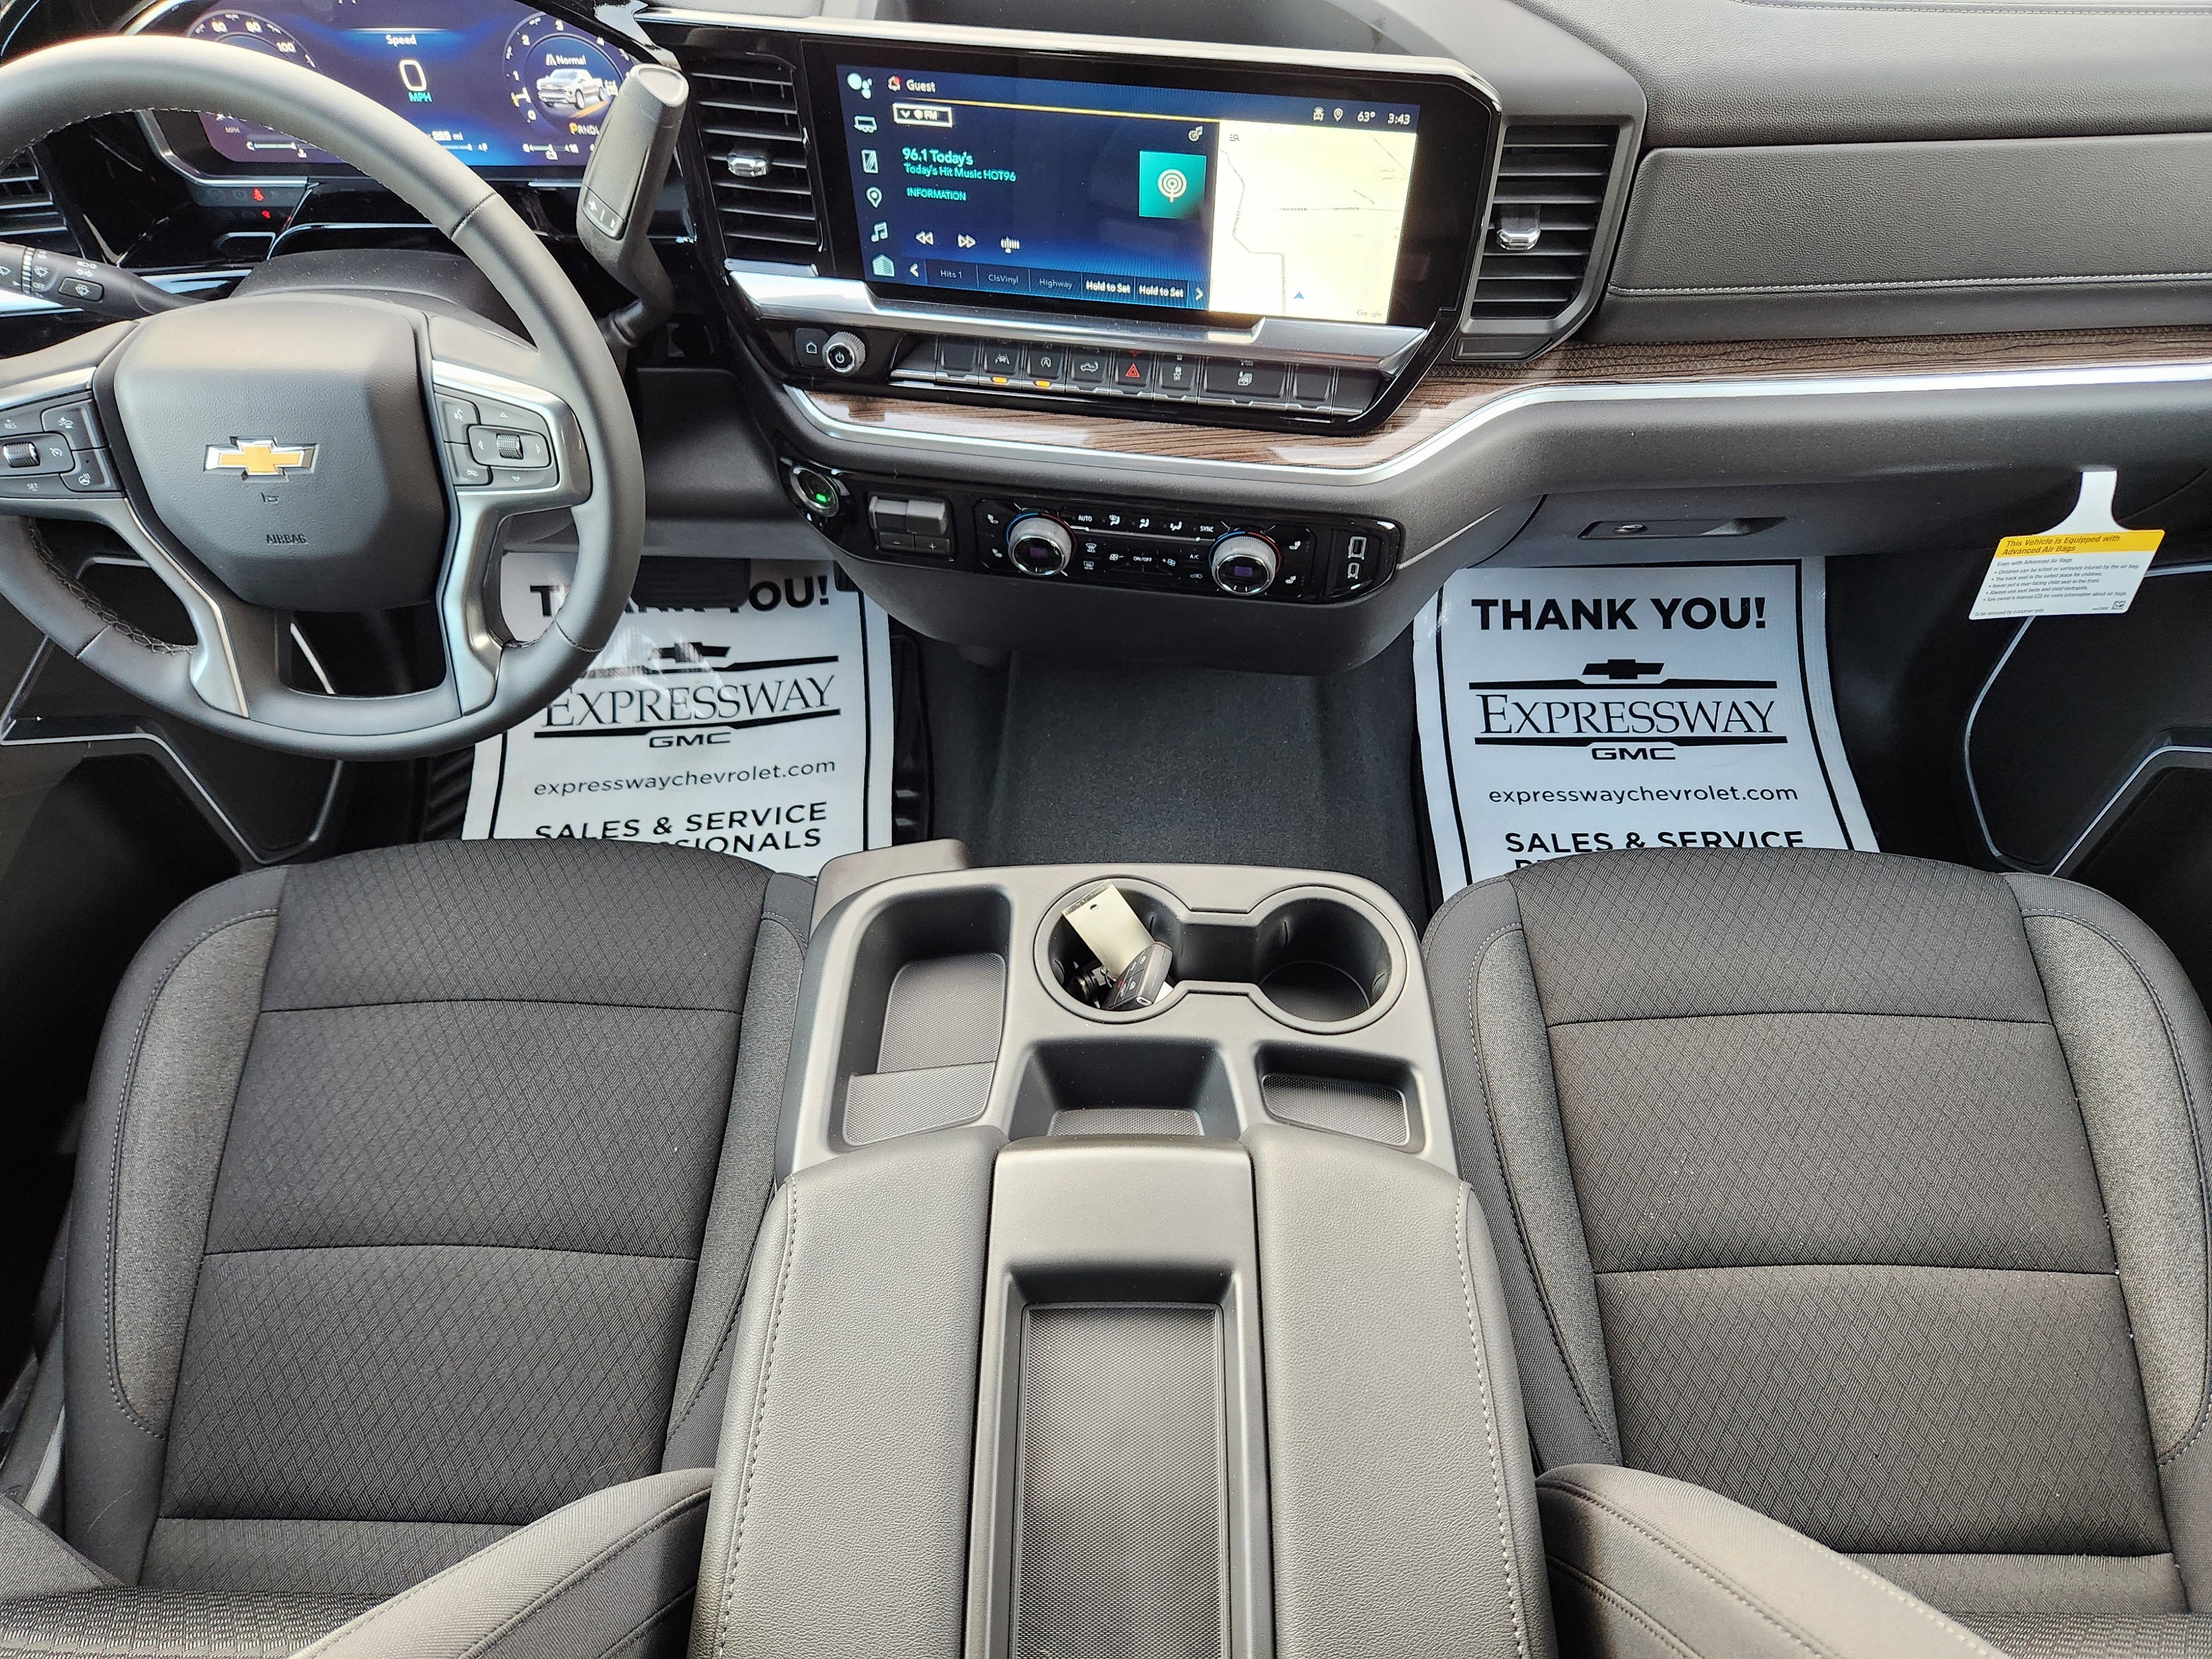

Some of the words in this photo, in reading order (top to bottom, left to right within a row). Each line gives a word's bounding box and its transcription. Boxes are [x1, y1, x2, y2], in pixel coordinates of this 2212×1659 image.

[276, 41, 296, 53] 100
[385, 34, 417, 48] Speed
[557, 55, 587, 66] Normal
[399, 59, 427, 91] 0
[906, 79, 936, 93] Guest
[408, 92, 432, 102] MPH
[924, 110, 937, 121] FM
[1387, 113, 1411, 126] 3:43
[902, 147, 927, 162] 96.1
[929, 149, 974, 167] Today's
[903, 163, 938, 178] Today's
[939, 165, 953, 177] Hit
[954, 167, 982, 179] Music
[983, 169, 1016, 181] HOT96
[906, 187, 967, 201] INFORMATION
[940, 270, 956, 278] Hits
[1039, 278, 1073, 290] Highway
[1086, 280, 1105, 291] Hold
[1107, 282, 1116, 292] to
[1117, 283, 1131, 294] Set
[1139, 284, 1158, 295] Hold
[1160, 286, 1168, 296] to
[1170, 287, 1184, 298] Set
[1357, 309, 1382, 318] Gogle
[266, 534, 307, 544] AIRBAG
[2064, 535, 2101, 545] Equipped
[2002, 546, 2042, 556] Advanced
[728, 575, 829, 613] OU!
[1471, 598, 1638, 630] THANK
[1650, 597, 1766, 629] YOU!
[541, 674, 836, 728] EXPRESSWAY
[1475, 694, 1775, 734] EXPRESSWAY
[649, 732, 732, 748] GMC
[1591, 748, 1676, 760] GMC
[534, 760, 836, 797] expresswaychevrolet.com
[1489, 785, 1799, 806] expresswaychevrolet.com
[535, 819, 641, 839] SALES
[653, 816, 674, 836] &
[686, 801, 828, 833] SERVICE
[1505, 832, 1614, 853] SALES
[1625, 831, 1646, 850] &
[1657, 830, 1804, 849] SERVICE
